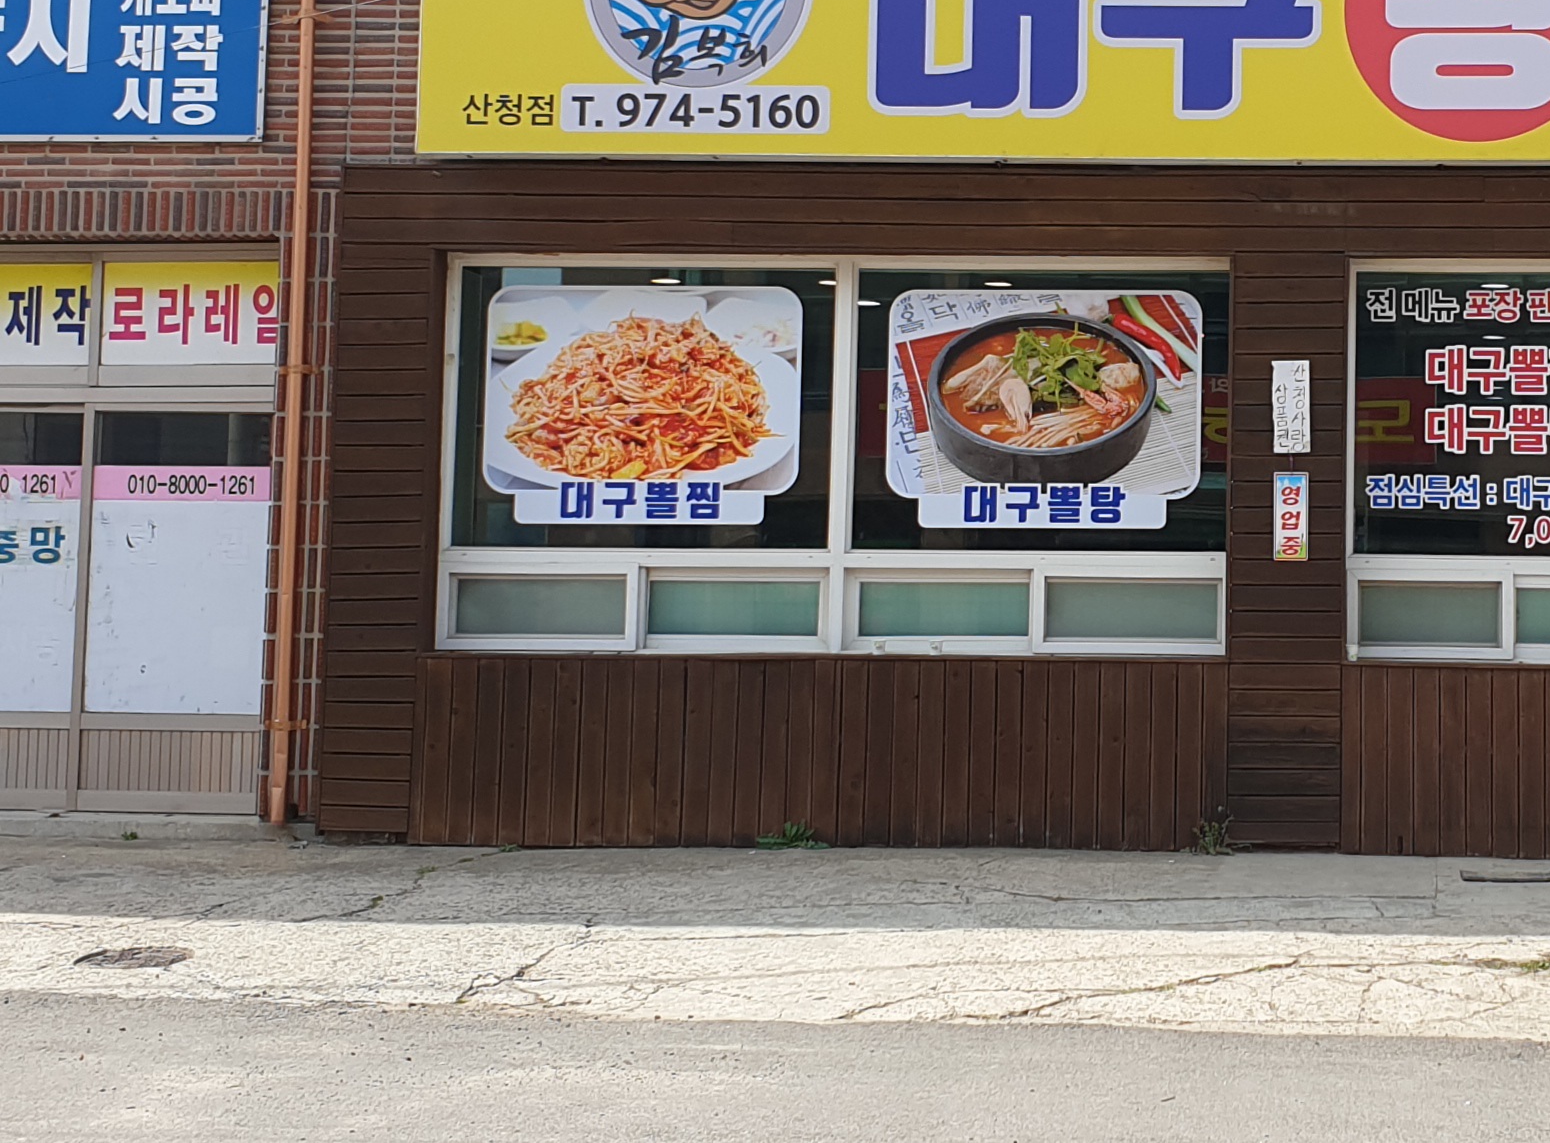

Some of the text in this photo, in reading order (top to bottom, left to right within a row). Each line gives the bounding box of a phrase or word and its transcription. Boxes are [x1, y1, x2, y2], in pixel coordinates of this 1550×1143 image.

[115, 24, 224, 72] 제작
[620, 14, 769, 85] 김복희
[113, 77, 219, 126] 시공
[461, 92, 820, 130] 산청점 T. 974-5160
[5, 284, 92, 346] 제작
[1366, 288, 1397, 323] 전
[1402, 288, 1459, 324] 메뉴
[1464, 288, 1523, 323] 포장
[126, 473, 256, 496] 010-8000-1261
[559, 481, 723, 521] 대구뽈찜
[962, 484, 1127, 525] 대구뽈탕
[1366, 474, 1481, 510] 점심특선
[1280, 484, 1302, 556] 영업중
